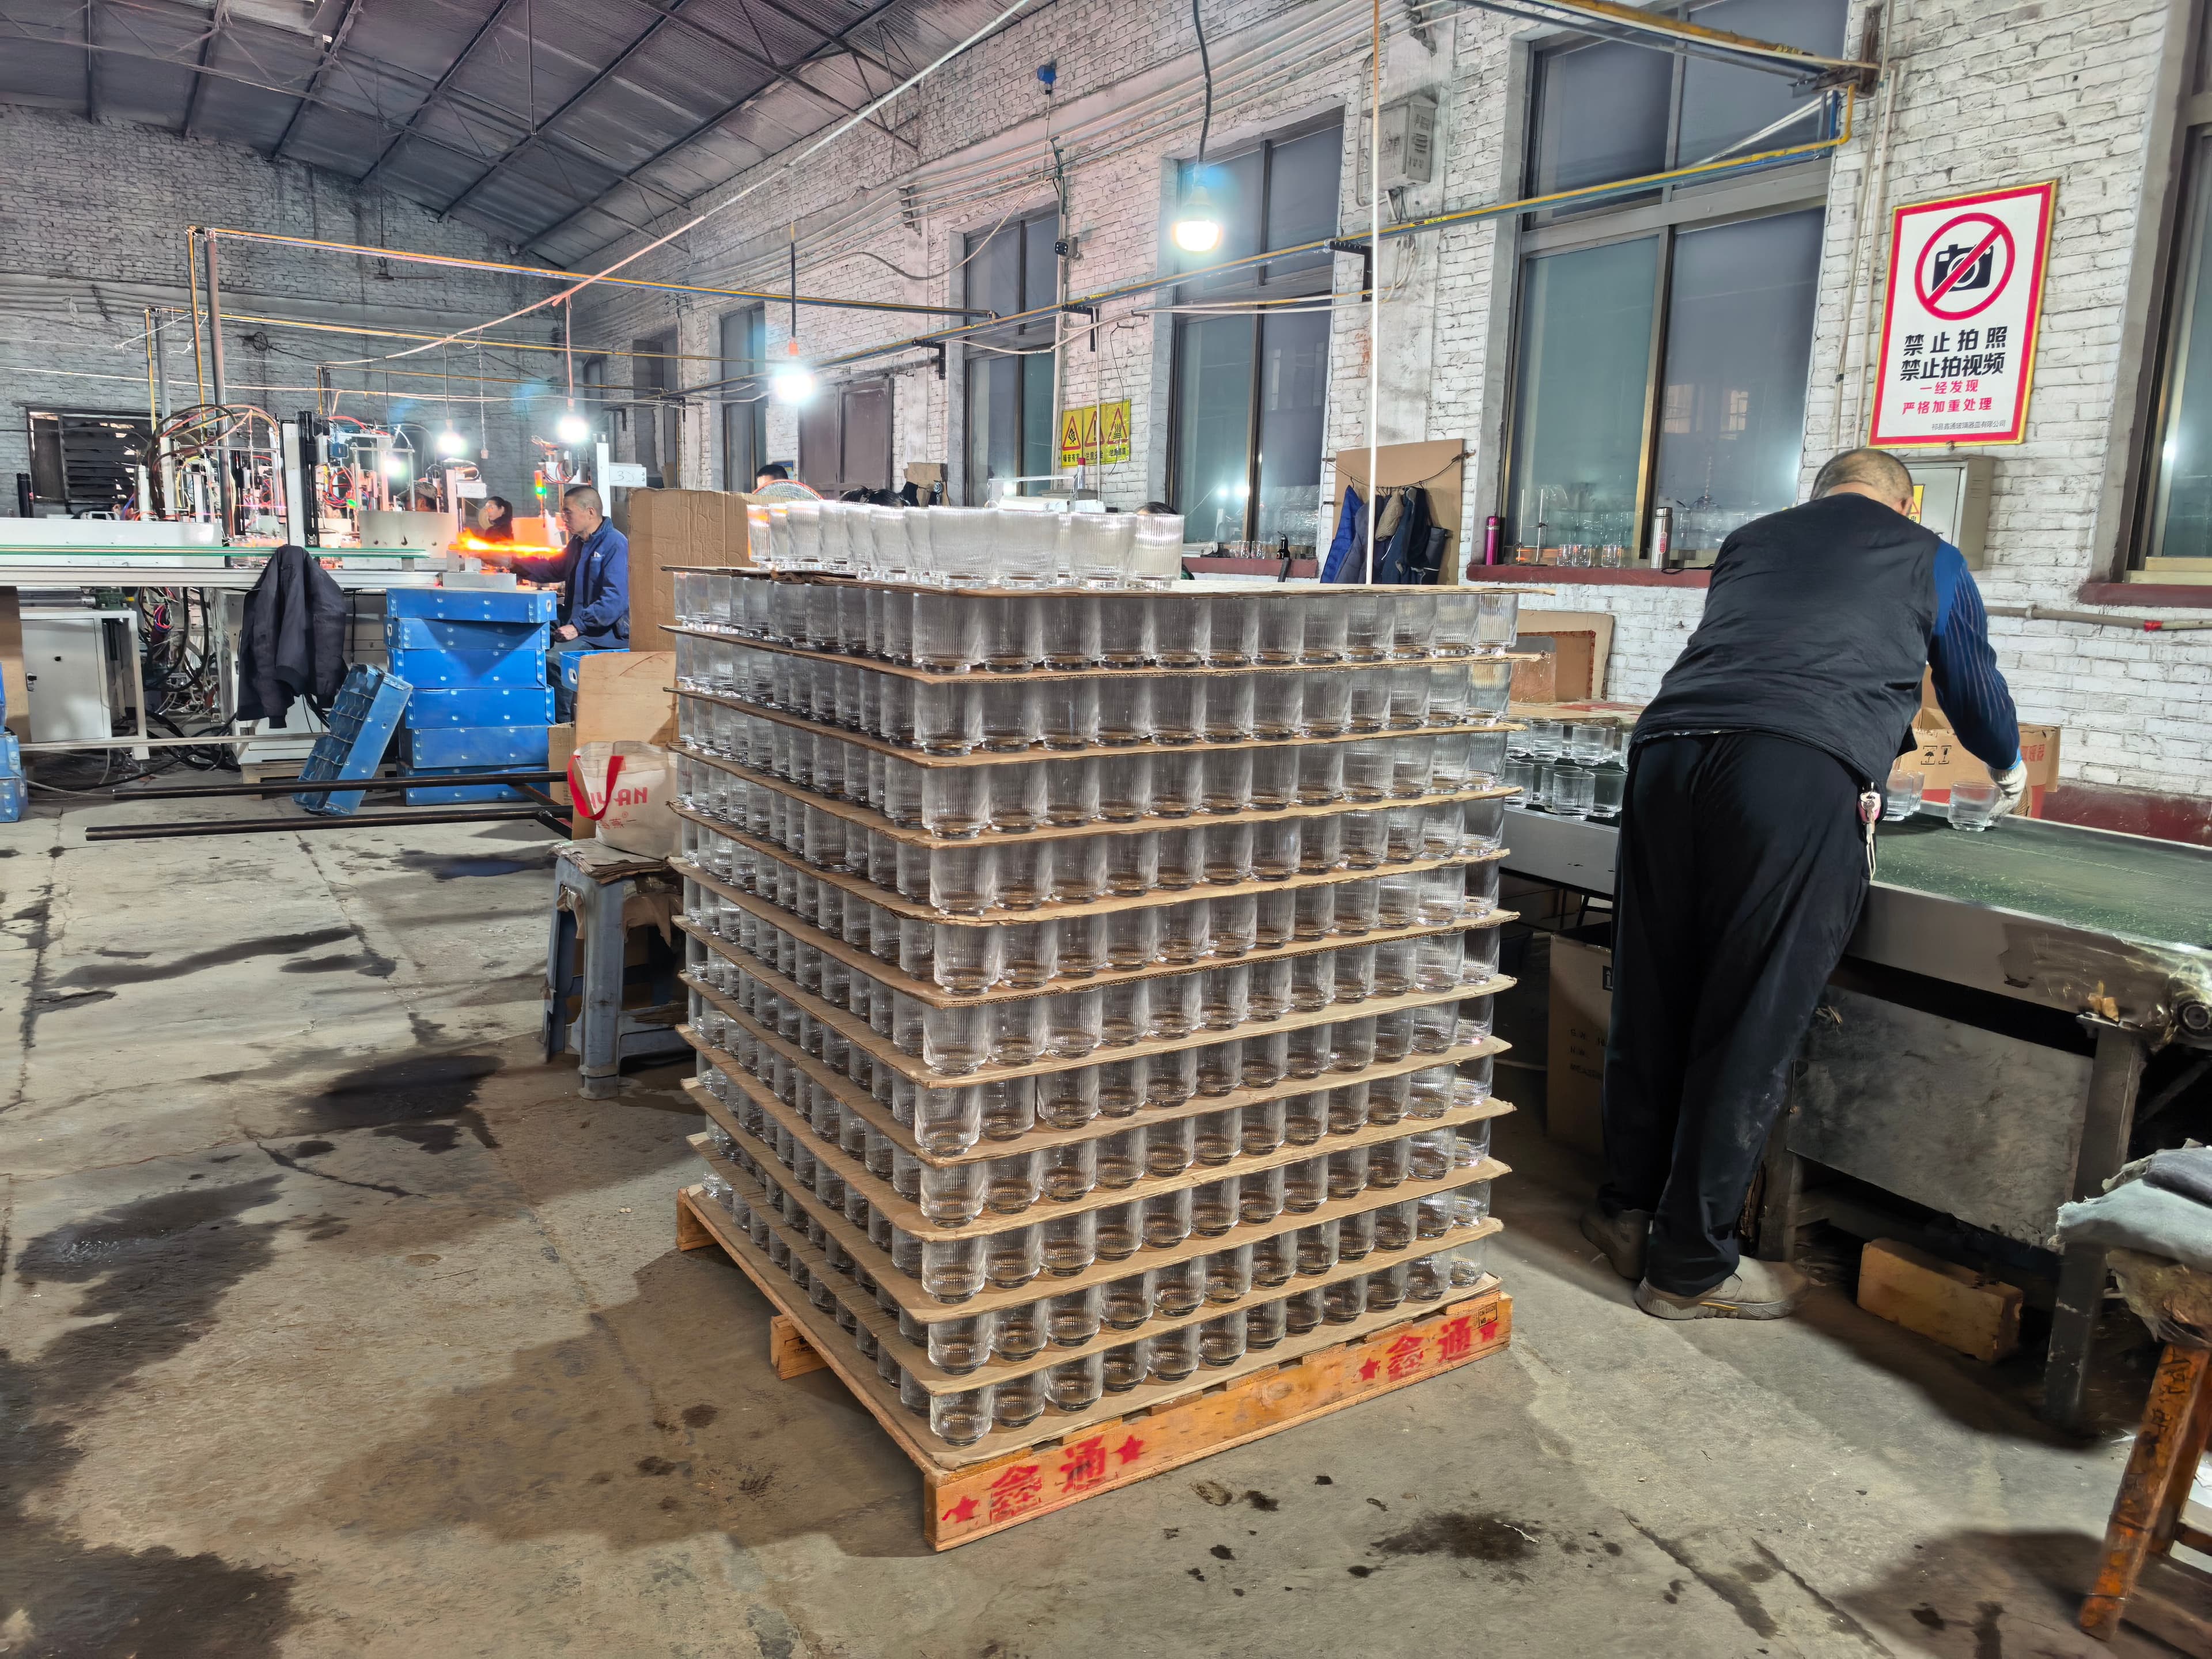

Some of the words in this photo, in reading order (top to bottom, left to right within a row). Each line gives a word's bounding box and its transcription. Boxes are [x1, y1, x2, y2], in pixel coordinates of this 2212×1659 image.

[1903, 326, 2008, 356] 禁止拍照
[1900, 352, 2006, 381] 禁止拍视频
[1919, 379, 1979, 395] 一经发现
[1902, 397, 1993, 415] 严格加重处理
